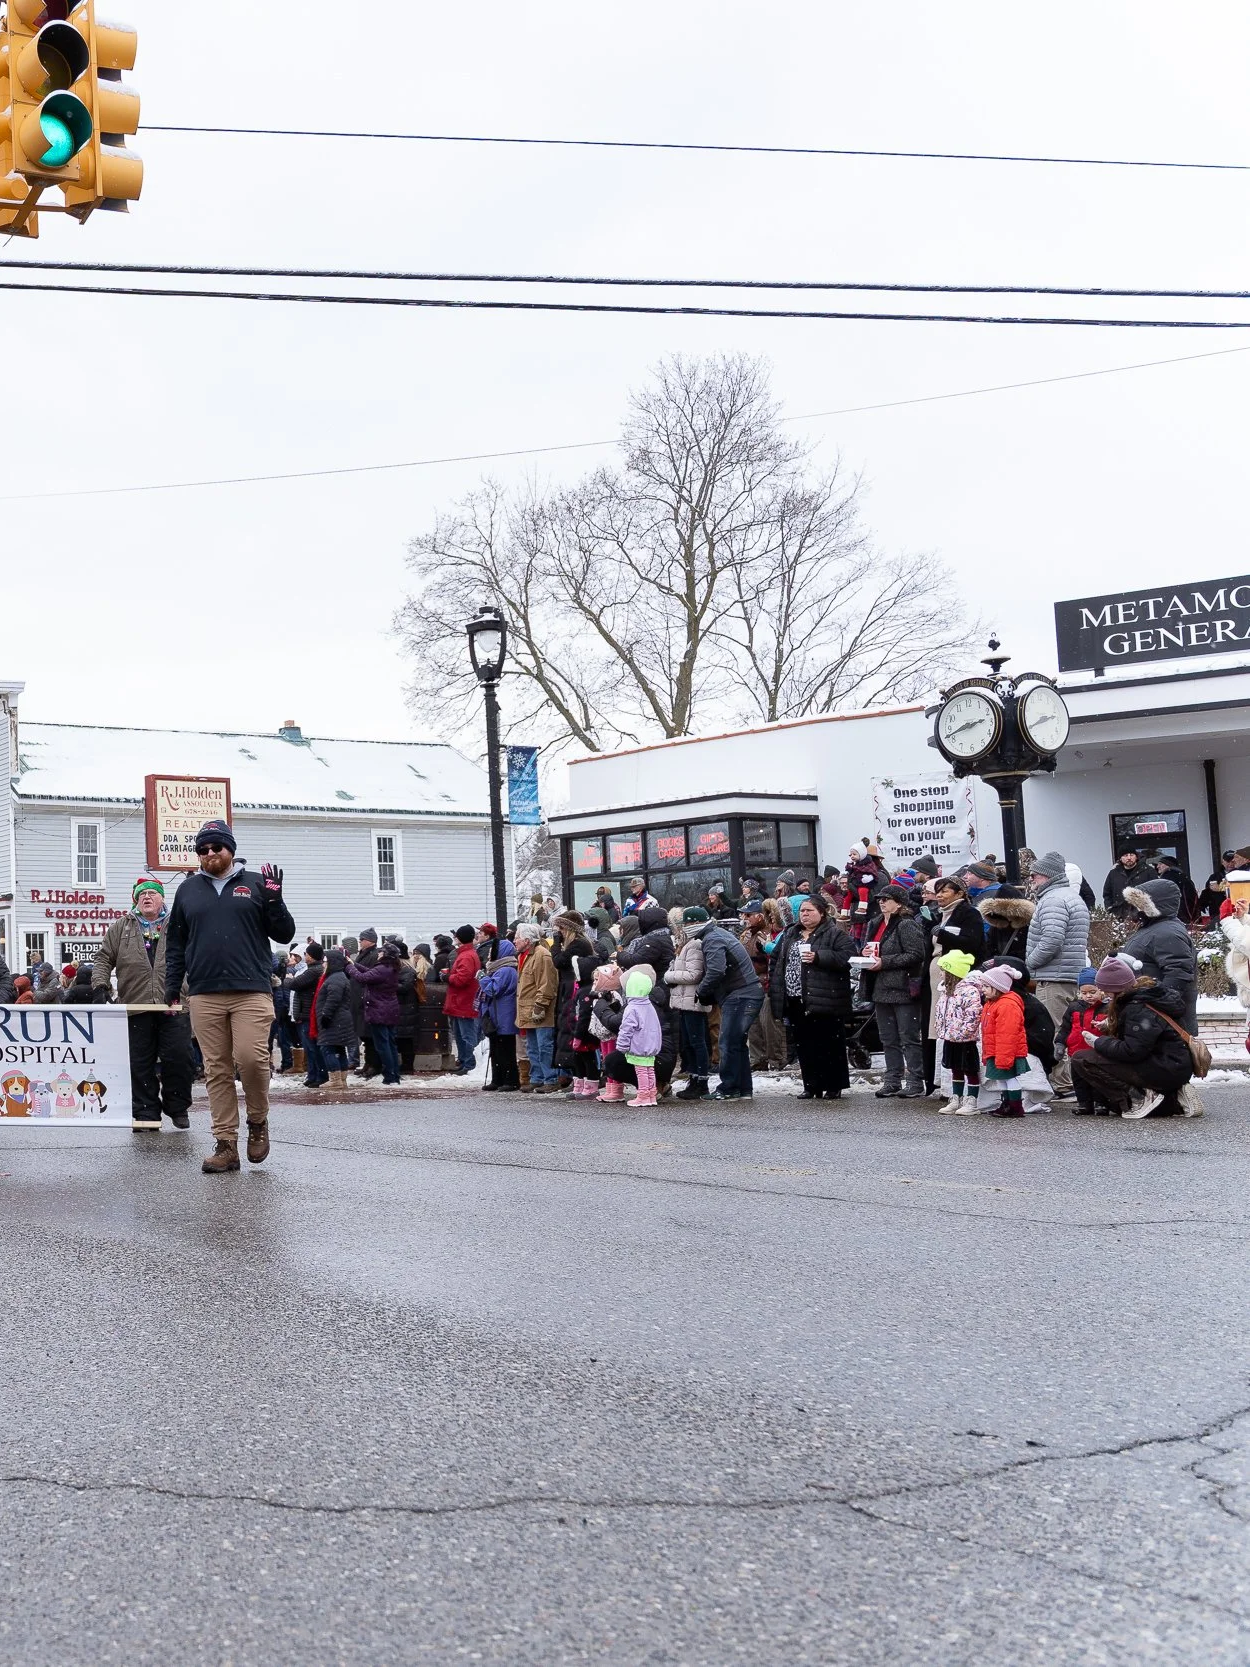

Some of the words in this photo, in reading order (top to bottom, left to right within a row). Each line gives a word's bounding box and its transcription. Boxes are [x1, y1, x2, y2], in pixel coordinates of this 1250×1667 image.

[1079, 585, 1250, 629] METAMO
[956, 704, 962, 712] 11
[965, 698, 972, 708] 12
[985, 707, 990, 716] 2
[893, 788, 918, 798] One
[920, 786, 949, 796] stop
[183, 800, 223, 808] ASSOCIATES
[893, 800, 954, 813] shopping
[165, 819, 202, 829] REALT
[887, 817, 902, 828] for
[904, 815, 956, 827] everyone
[1136, 823, 1166, 834] OPEN
[163, 834, 178, 843] DDA
[657, 836, 684, 848] BOOKS
[899, 832, 915, 842] on
[917, 830, 945, 842] your
[658, 847, 685, 858] CARDS
[891, 844, 928, 857] "nice"
[930, 843, 961, 855] list...
[55, 906, 128, 919] associates
[55, 922, 111, 937] REALT
